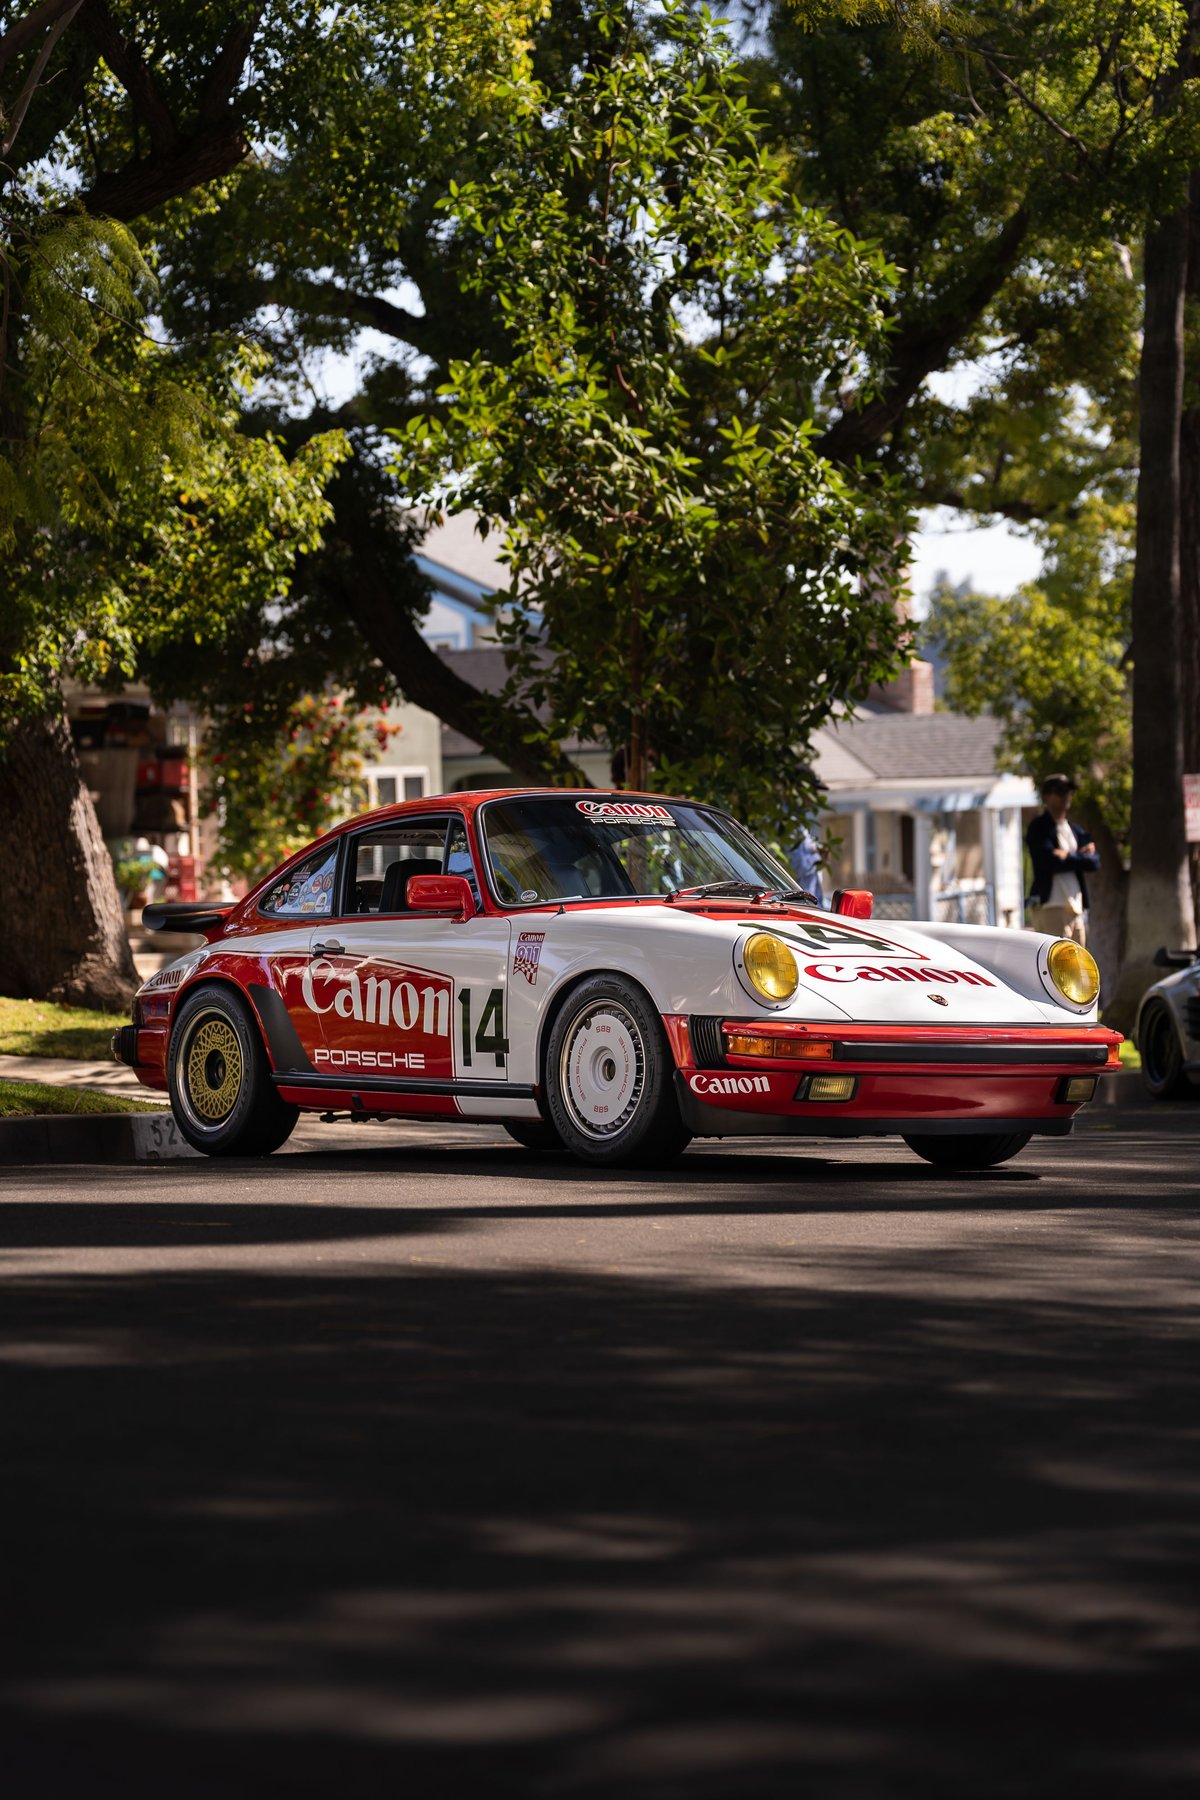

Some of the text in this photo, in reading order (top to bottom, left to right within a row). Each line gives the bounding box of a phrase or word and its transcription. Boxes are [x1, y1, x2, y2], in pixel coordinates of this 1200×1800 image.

[575, 800, 673, 819] Canon
[590, 818, 677, 827] PORSCHE
[520, 933, 544, 942] Canon
[738, 923, 895, 951] 14
[517, 946, 540, 964] 911
[804, 964, 997, 987] Canon
[302, 958, 449, 1037] Canon
[211, 1032, 225, 1044] BBS
[458, 988, 510, 1068] 14
[596, 1025, 611, 1034] BBS
[314, 1049, 425, 1069] PORSCHE
[575, 1037, 588, 1101] PORSCHE
[617, 1037, 629, 1101] PORSCHE
[689, 1074, 771, 1094] Canon
[593, 1105, 609, 1113] BBS
[151, 1118, 189, 1147] 52
